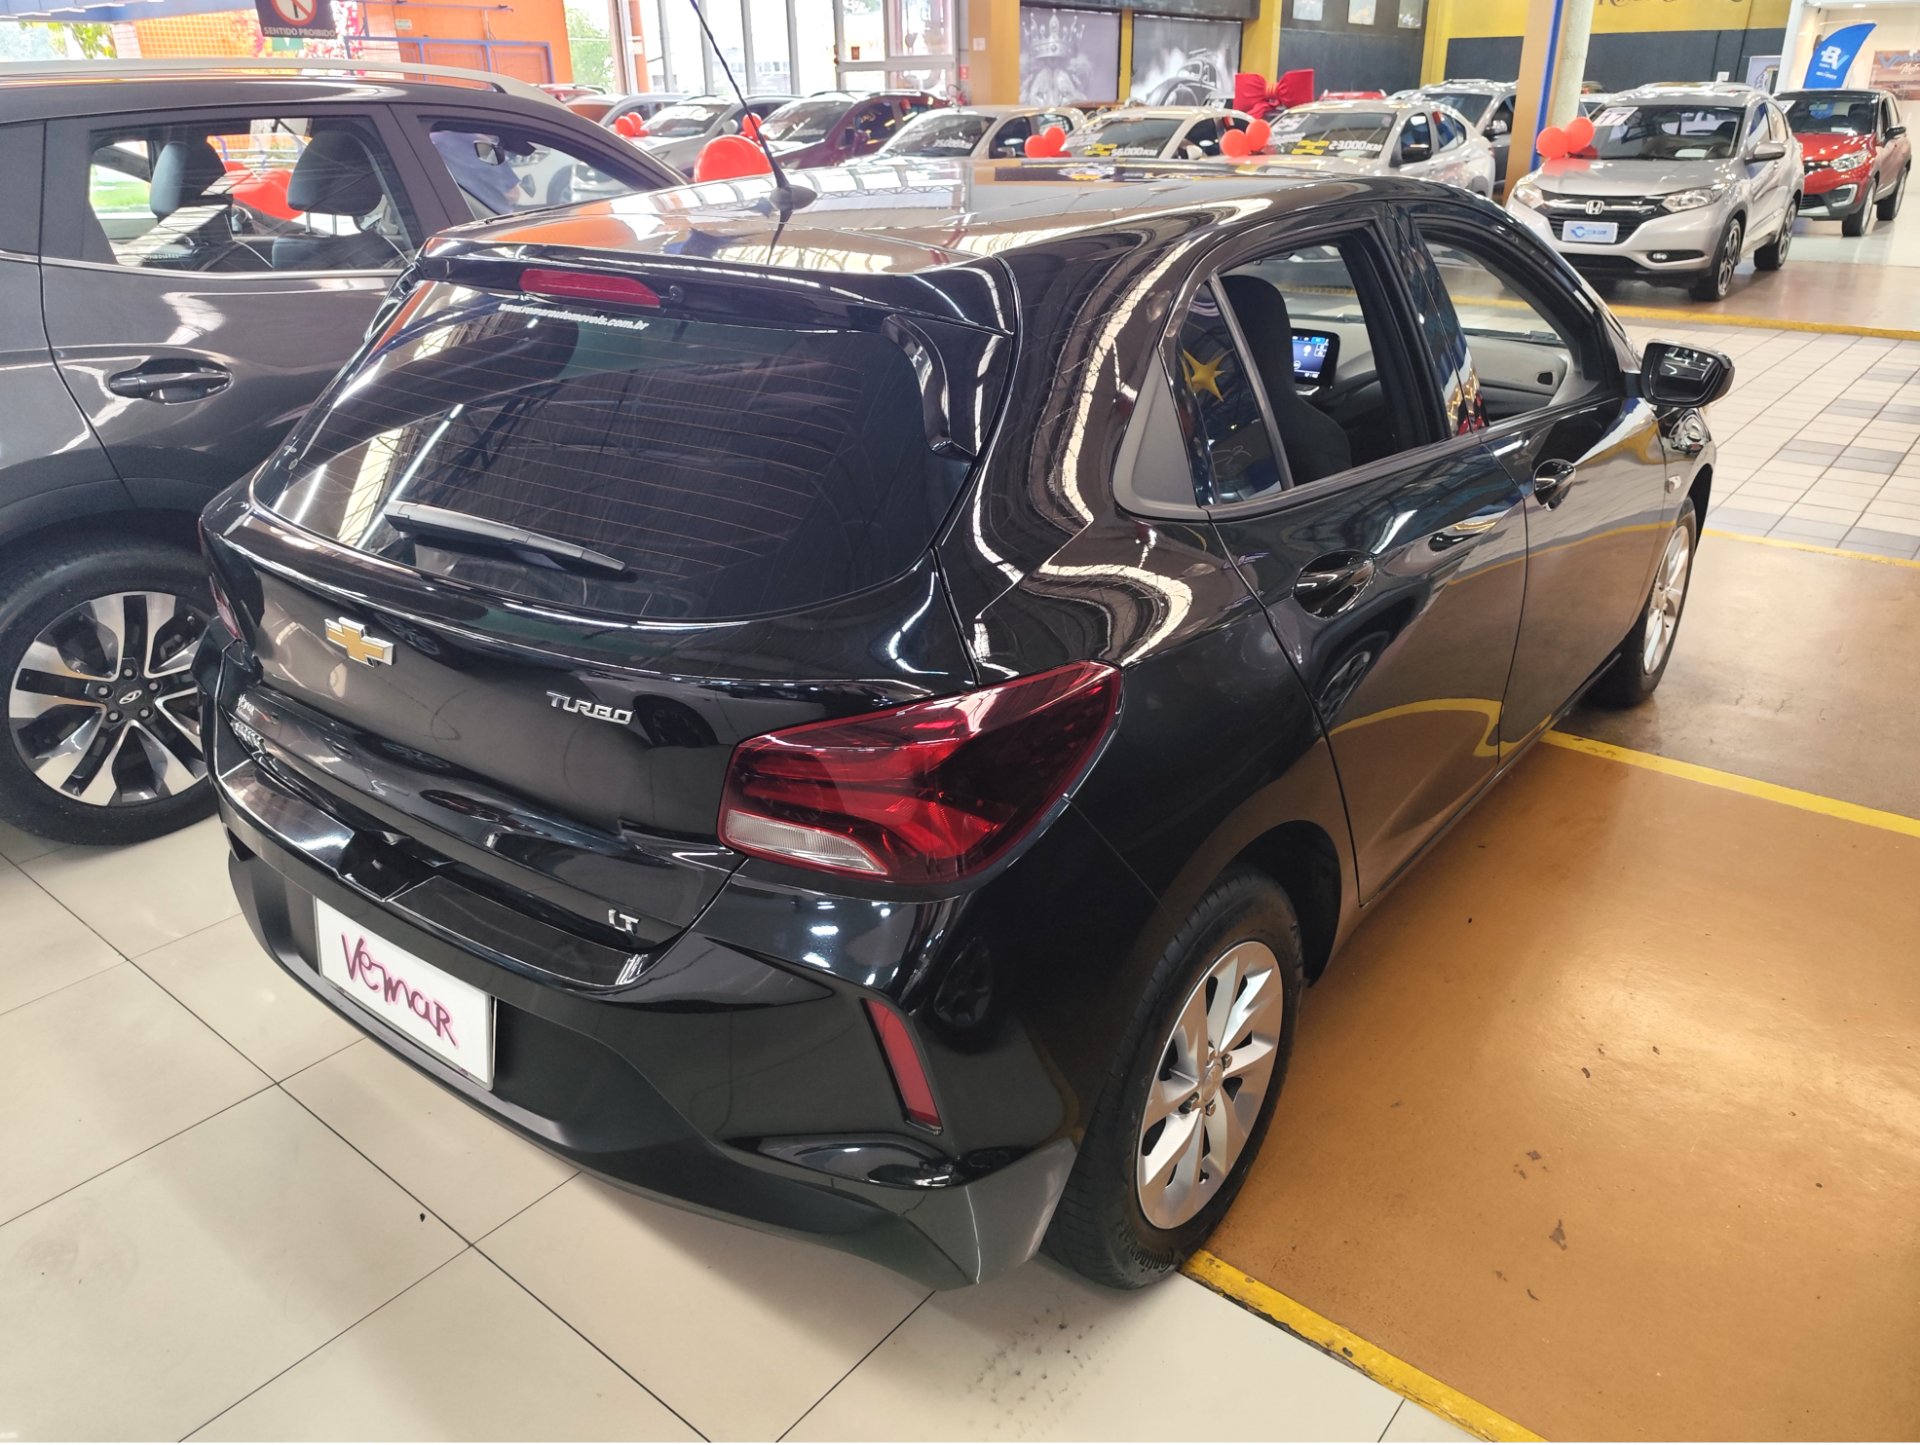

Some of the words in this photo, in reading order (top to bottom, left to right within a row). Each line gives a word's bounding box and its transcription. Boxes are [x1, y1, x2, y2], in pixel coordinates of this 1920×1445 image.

[263, 26, 298, 36] SENTIDO
[299, 27, 336, 37] PROIBIDO
[546, 691, 634, 725] TURBO
[608, 909, 640, 933] LT
